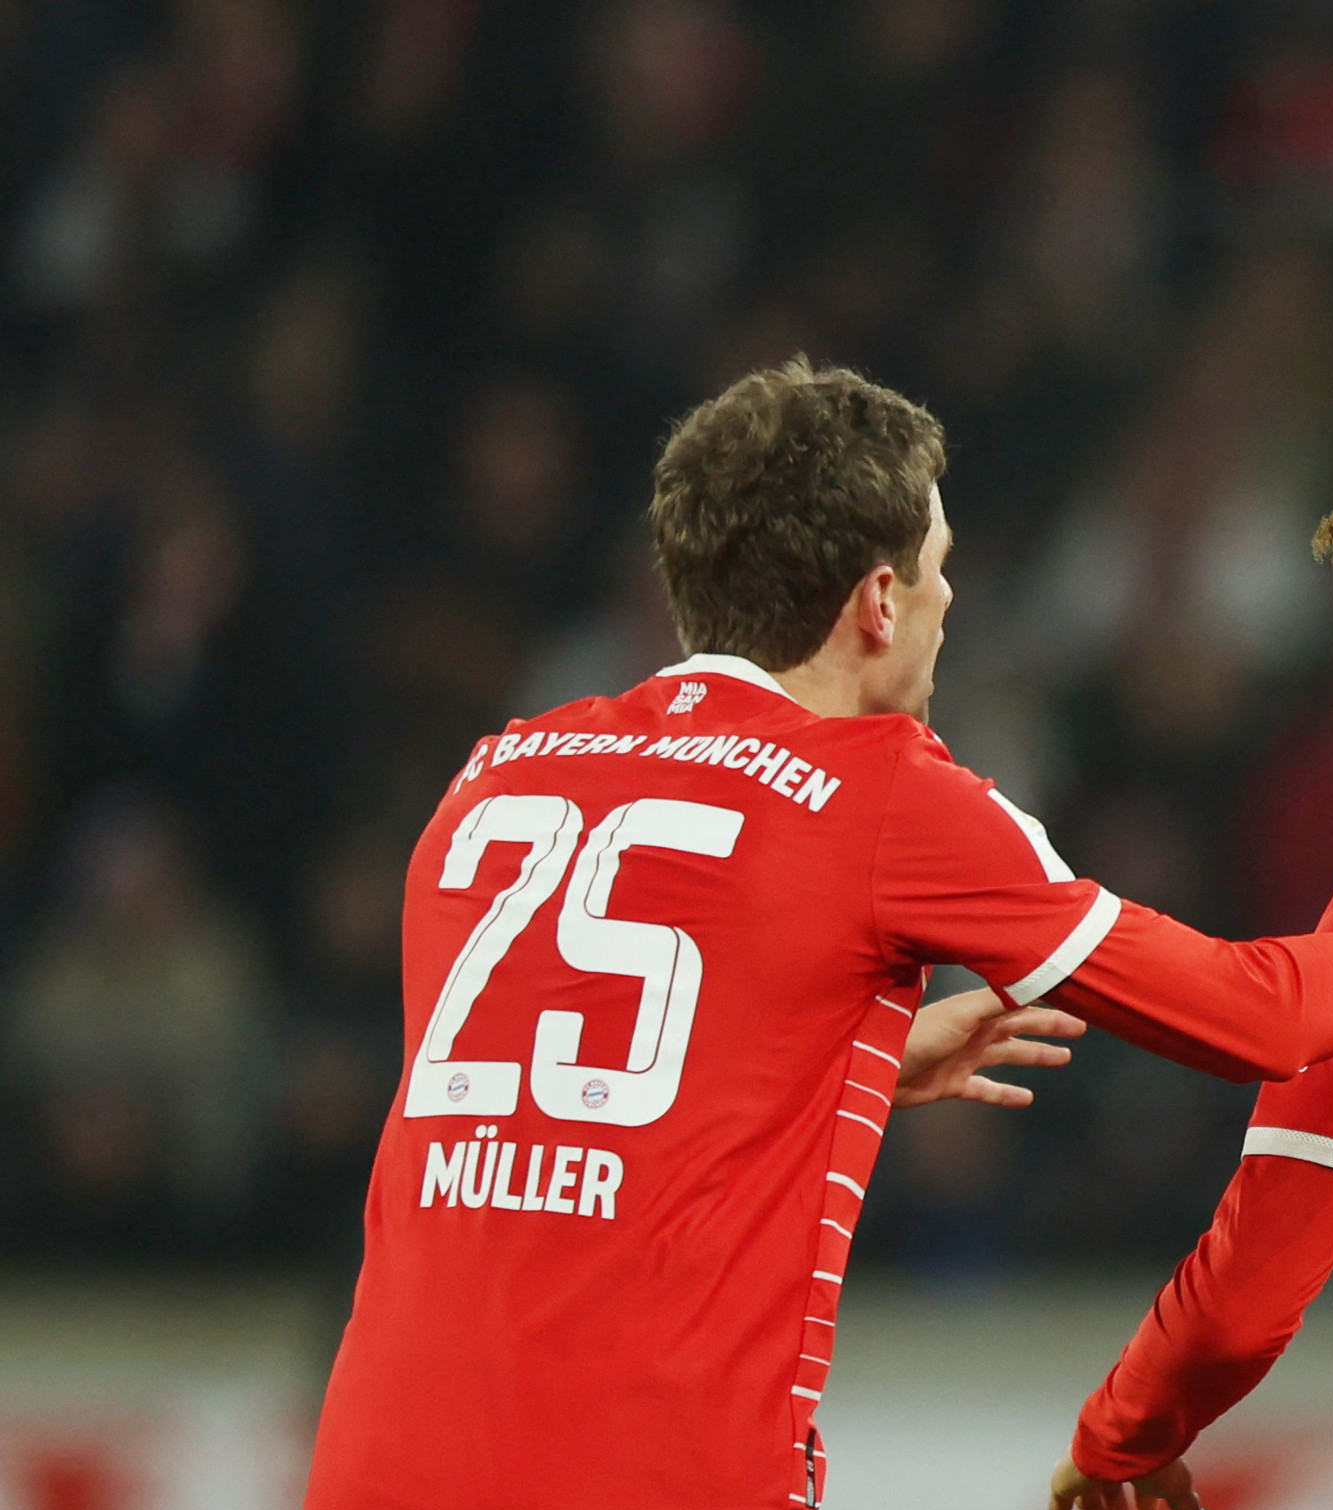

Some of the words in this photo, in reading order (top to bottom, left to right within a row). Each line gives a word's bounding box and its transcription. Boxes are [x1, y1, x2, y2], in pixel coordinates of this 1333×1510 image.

[490, 732, 647, 768] BAYERN
[640, 734, 842, 813] MÜNCHEN
[403, 794, 745, 1127] 25
[420, 1124, 624, 1221] MÜLLER
